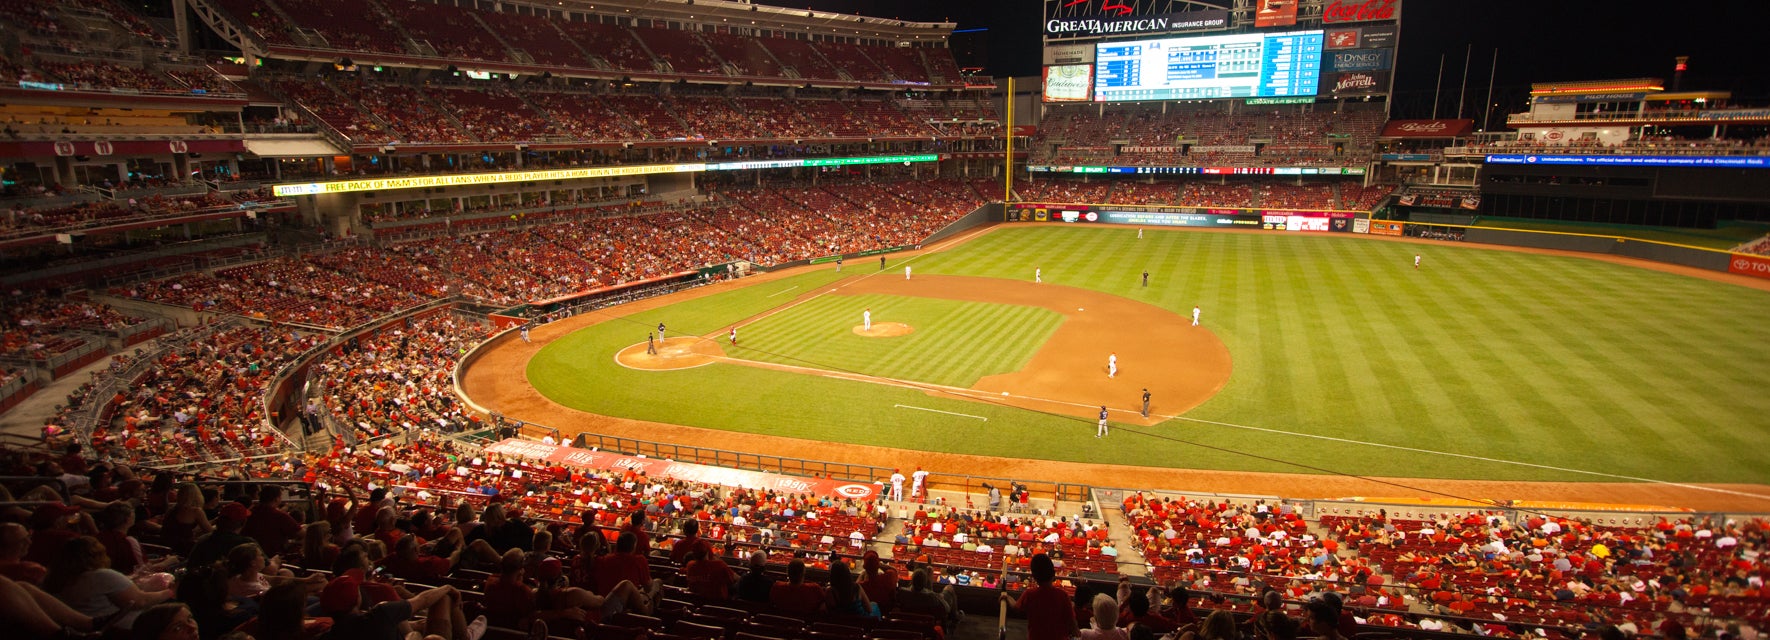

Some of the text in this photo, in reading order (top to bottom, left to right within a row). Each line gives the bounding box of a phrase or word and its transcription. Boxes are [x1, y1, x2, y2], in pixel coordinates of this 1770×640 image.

[1171, 20, 1204, 28] INSURANCE
[1204, 19, 1224, 27] GROUP
[1344, 53, 1380, 62] DYNEGY
[1351, 73, 1366, 81] John
[1332, 76, 1376, 92] Morrell
[1398, 121, 1447, 131] Reds
[325, 182, 346, 191] FREE
[348, 181, 372, 190] PACK
[374, 181, 385, 189] OF
[418, 177, 434, 186] FOR
[435, 176, 449, 185] ALL
[451, 175, 472, 184] FANS
[473, 174, 497, 183] WHEN
[498, 173, 503, 181] A
[505, 173, 523, 181] REDS
[524, 171, 549, 180] PLAYER
[550, 171, 565, 179] HITS
[565, 170, 570, 178] A
[571, 169, 589, 177] HOME
[778, 478, 807, 491] 1990
[846, 487, 871, 495] REDS
